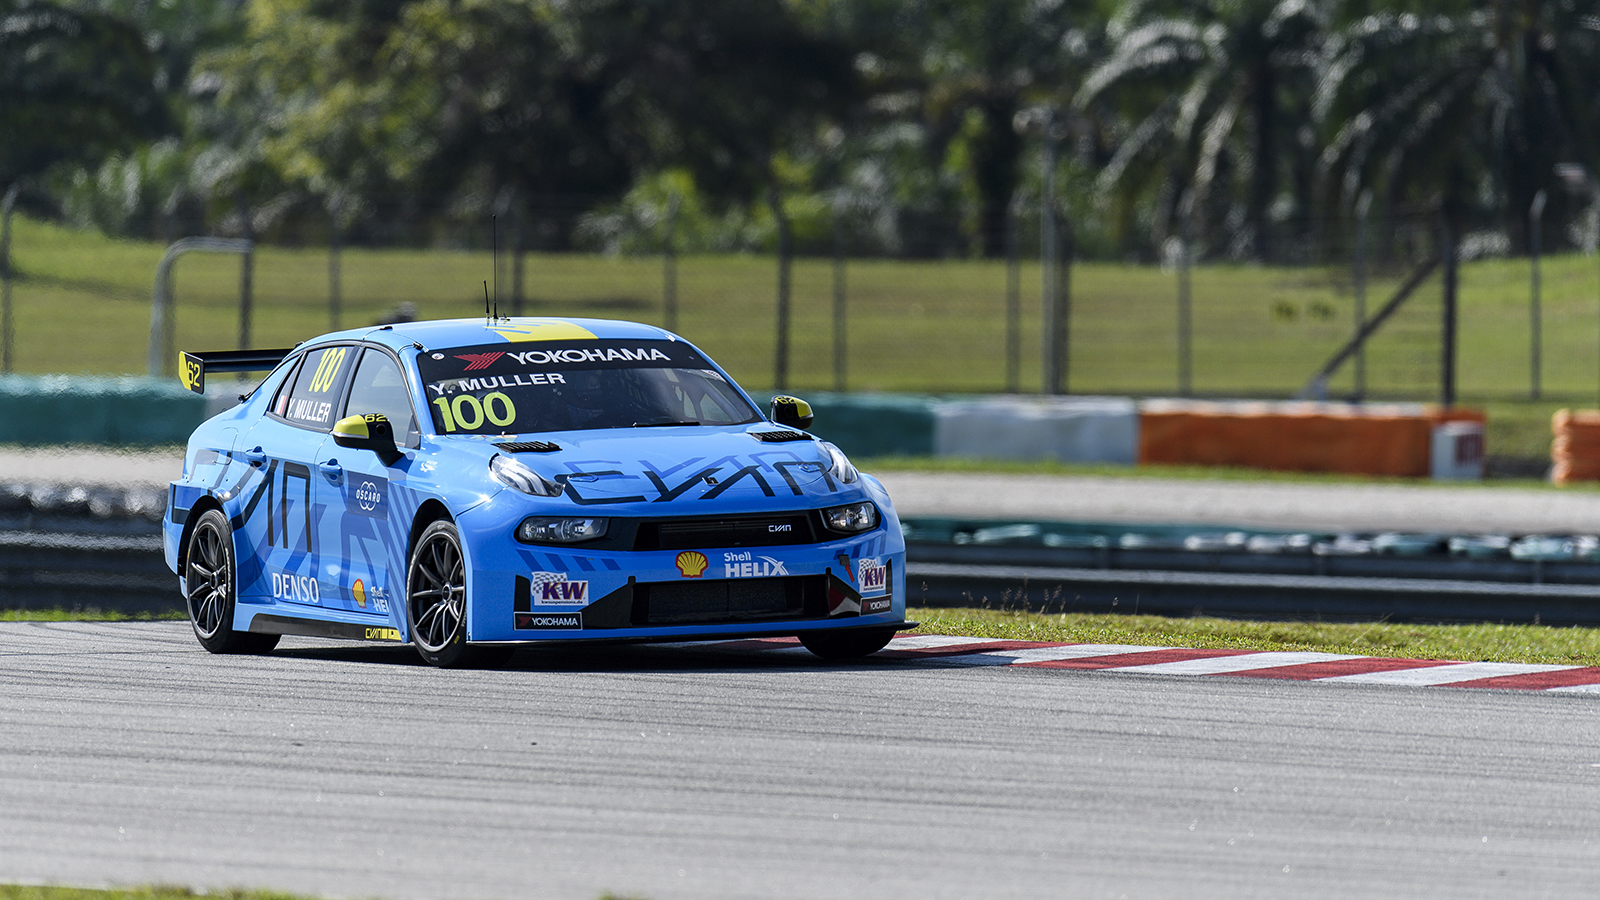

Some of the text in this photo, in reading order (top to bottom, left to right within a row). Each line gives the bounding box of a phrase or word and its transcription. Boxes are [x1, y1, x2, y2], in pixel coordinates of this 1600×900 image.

[507, 348, 672, 365] YOKOHAMA
[187, 360, 201, 388] 62
[308, 347, 347, 393] 100
[428, 373, 567, 396] Y. MULLER
[293, 399, 332, 423] MULLER
[364, 413, 387, 423] 62
[432, 391, 516, 432] 100
[356, 489, 381, 503] OSCARO
[724, 552, 752, 562] Shell
[725, 561, 789, 578] HELIX
[864, 567, 886, 587] KW
[272, 572, 320, 604] DENSO
[542, 582, 587, 600] KW
[532, 617, 578, 626] YOKOHAMA
